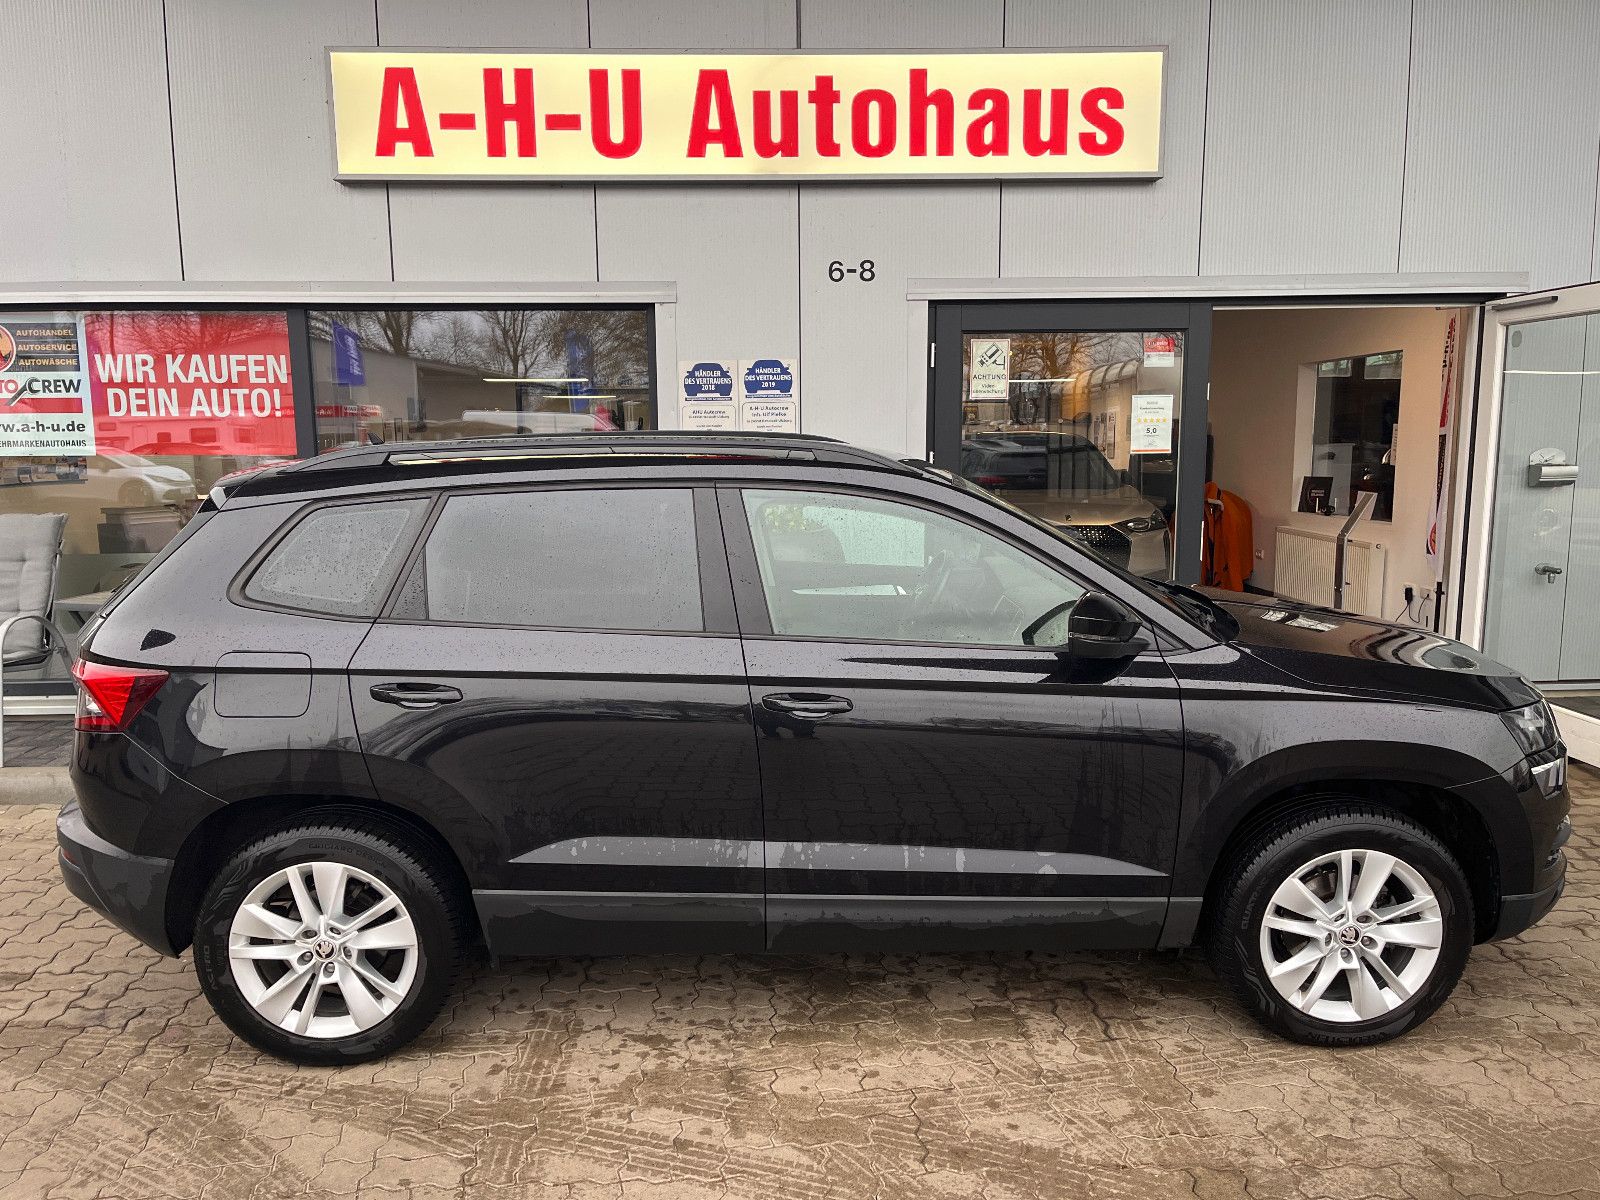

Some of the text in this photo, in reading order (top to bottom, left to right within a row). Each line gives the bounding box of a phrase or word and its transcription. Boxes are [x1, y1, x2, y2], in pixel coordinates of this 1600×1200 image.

[375, 67, 1125, 159] A-H-U Autohaus
[828, 260, 877, 283] 6-8
[16, 329, 74, 337] AUTOHANDEL
[17, 343, 77, 351] AUTOSERVICE
[18, 357, 78, 366] AUTOWÄSCHE
[94, 354, 288, 384] WIR KAUFEN
[695, 369, 721, 377] HÄNDLER
[755, 366, 781, 374] HÄNDLER
[685, 377, 732, 385] DES VERTRAUENS
[745, 374, 792, 382] DES VERTRAUENS
[761, 381, 776, 389] 2019
[106, 387, 282, 418] DEIN AUTO!
[0, 420, 86, 433] w.a-h-u.de
[1145, 427, 1157, 435] 5,0
